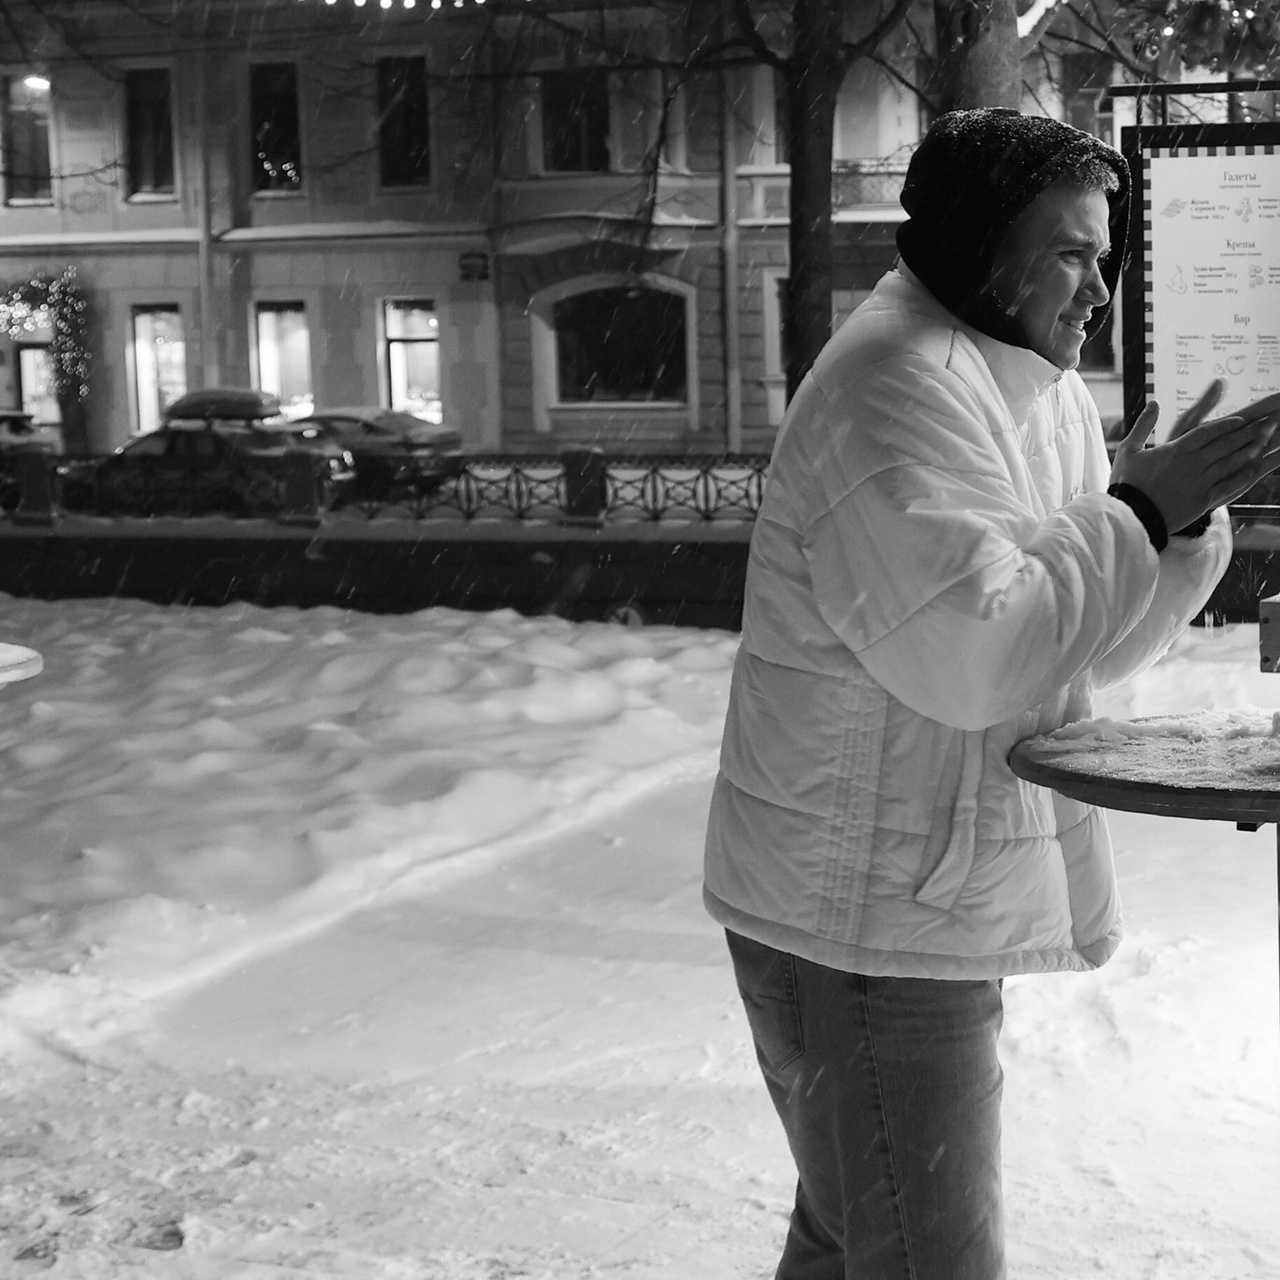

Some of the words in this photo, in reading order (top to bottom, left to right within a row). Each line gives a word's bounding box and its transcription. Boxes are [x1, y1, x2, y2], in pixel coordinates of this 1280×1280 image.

[1223, 171, 1257, 181] Галеты
[1226, 239, 1256, 251] Крепы
[1233, 312, 1251, 326] Бар
